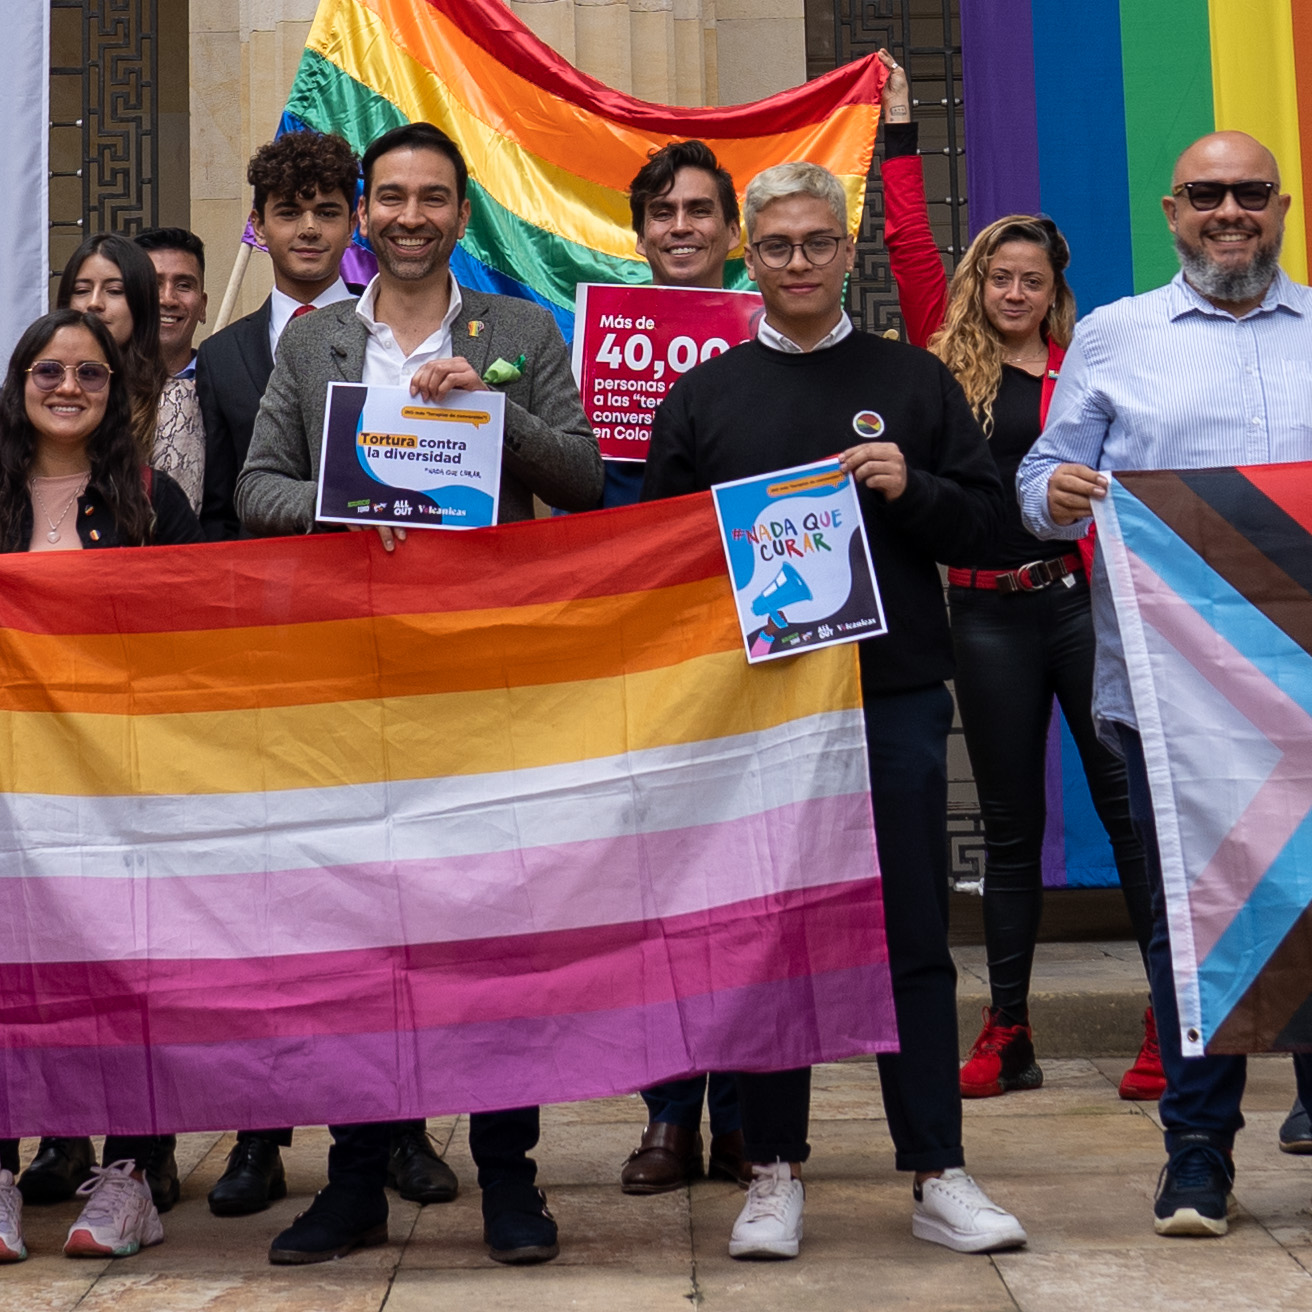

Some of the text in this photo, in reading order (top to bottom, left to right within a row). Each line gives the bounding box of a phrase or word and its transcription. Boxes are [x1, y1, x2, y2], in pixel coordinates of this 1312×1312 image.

[599, 315, 655, 329] Más de
[594, 378, 666, 393] personas
[593, 394, 604, 406] a
[607, 392, 630, 407] las
[592, 425, 652, 441] en Colo
[360, 432, 467, 451] Tortura contra
[367, 446, 462, 464] la diversidad
[393, 506, 413, 516] OUT
[394, 499, 409, 508] ALL
[732, 508, 843, 545] #NADA QUE
[760, 532, 832, 561] CURAR
